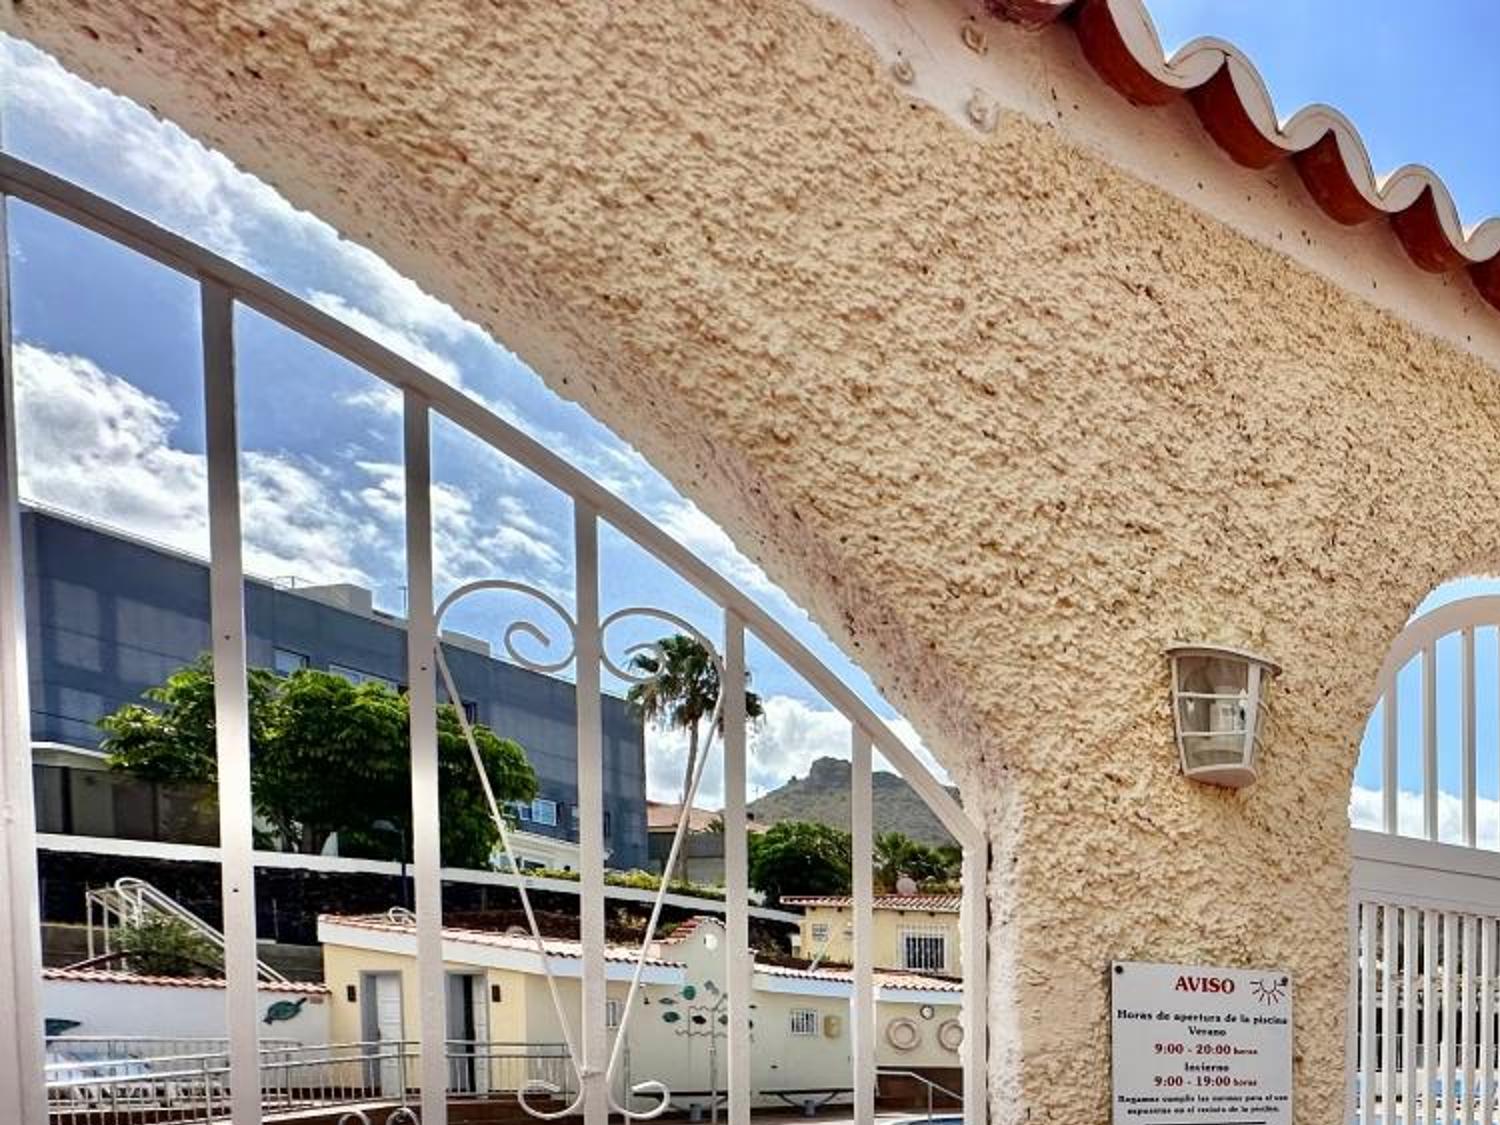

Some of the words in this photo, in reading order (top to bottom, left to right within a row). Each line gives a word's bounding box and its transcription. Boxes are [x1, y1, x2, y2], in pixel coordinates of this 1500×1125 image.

[1175, 975, 1235, 994] AVISO
[1117, 1009, 1152, 1020] Horas
[1155, 1011, 1171, 1021] de
[1173, 1013, 1221, 1023] apertura
[1224, 1013, 1237, 1023] de
[1240, 1013, 1250, 1023] la
[1253, 1014, 1288, 1026] piscina
[1187, 1026, 1227, 1037] Verano
[1154, 1043, 1184, 1055] 9:00
[1195, 1043, 1231, 1055] 20:00
[1153, 1076, 1183, 1087] 9:00
[1196, 1076, 1231, 1087] 19:00
